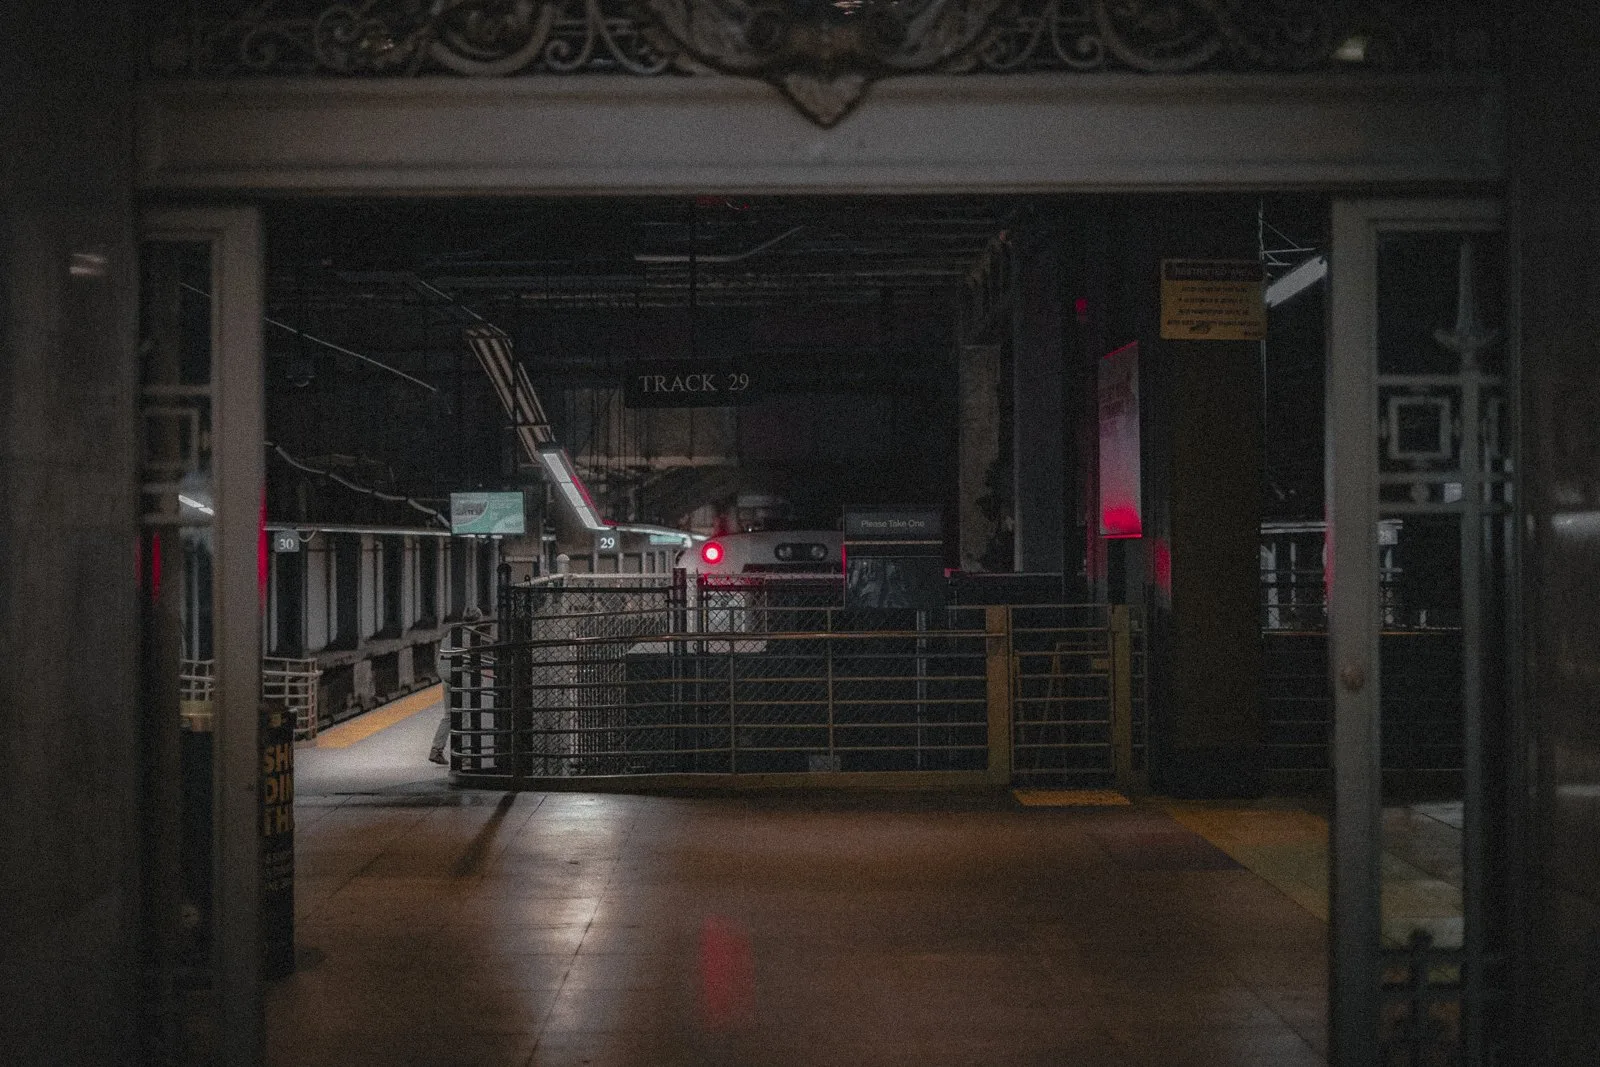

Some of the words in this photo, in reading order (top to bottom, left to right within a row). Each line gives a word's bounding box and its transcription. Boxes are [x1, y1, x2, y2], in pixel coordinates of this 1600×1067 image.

[638, 373, 718, 392] TRACK
[728, 373, 749, 391] 29
[861, 520, 887, 528] Please
[888, 519, 906, 528] Take
[908, 519, 925, 528] One
[280, 538, 294, 550] 30
[600, 537, 615, 549] 29
[264, 743, 292, 774] SH
[264, 804, 292, 836] TH
